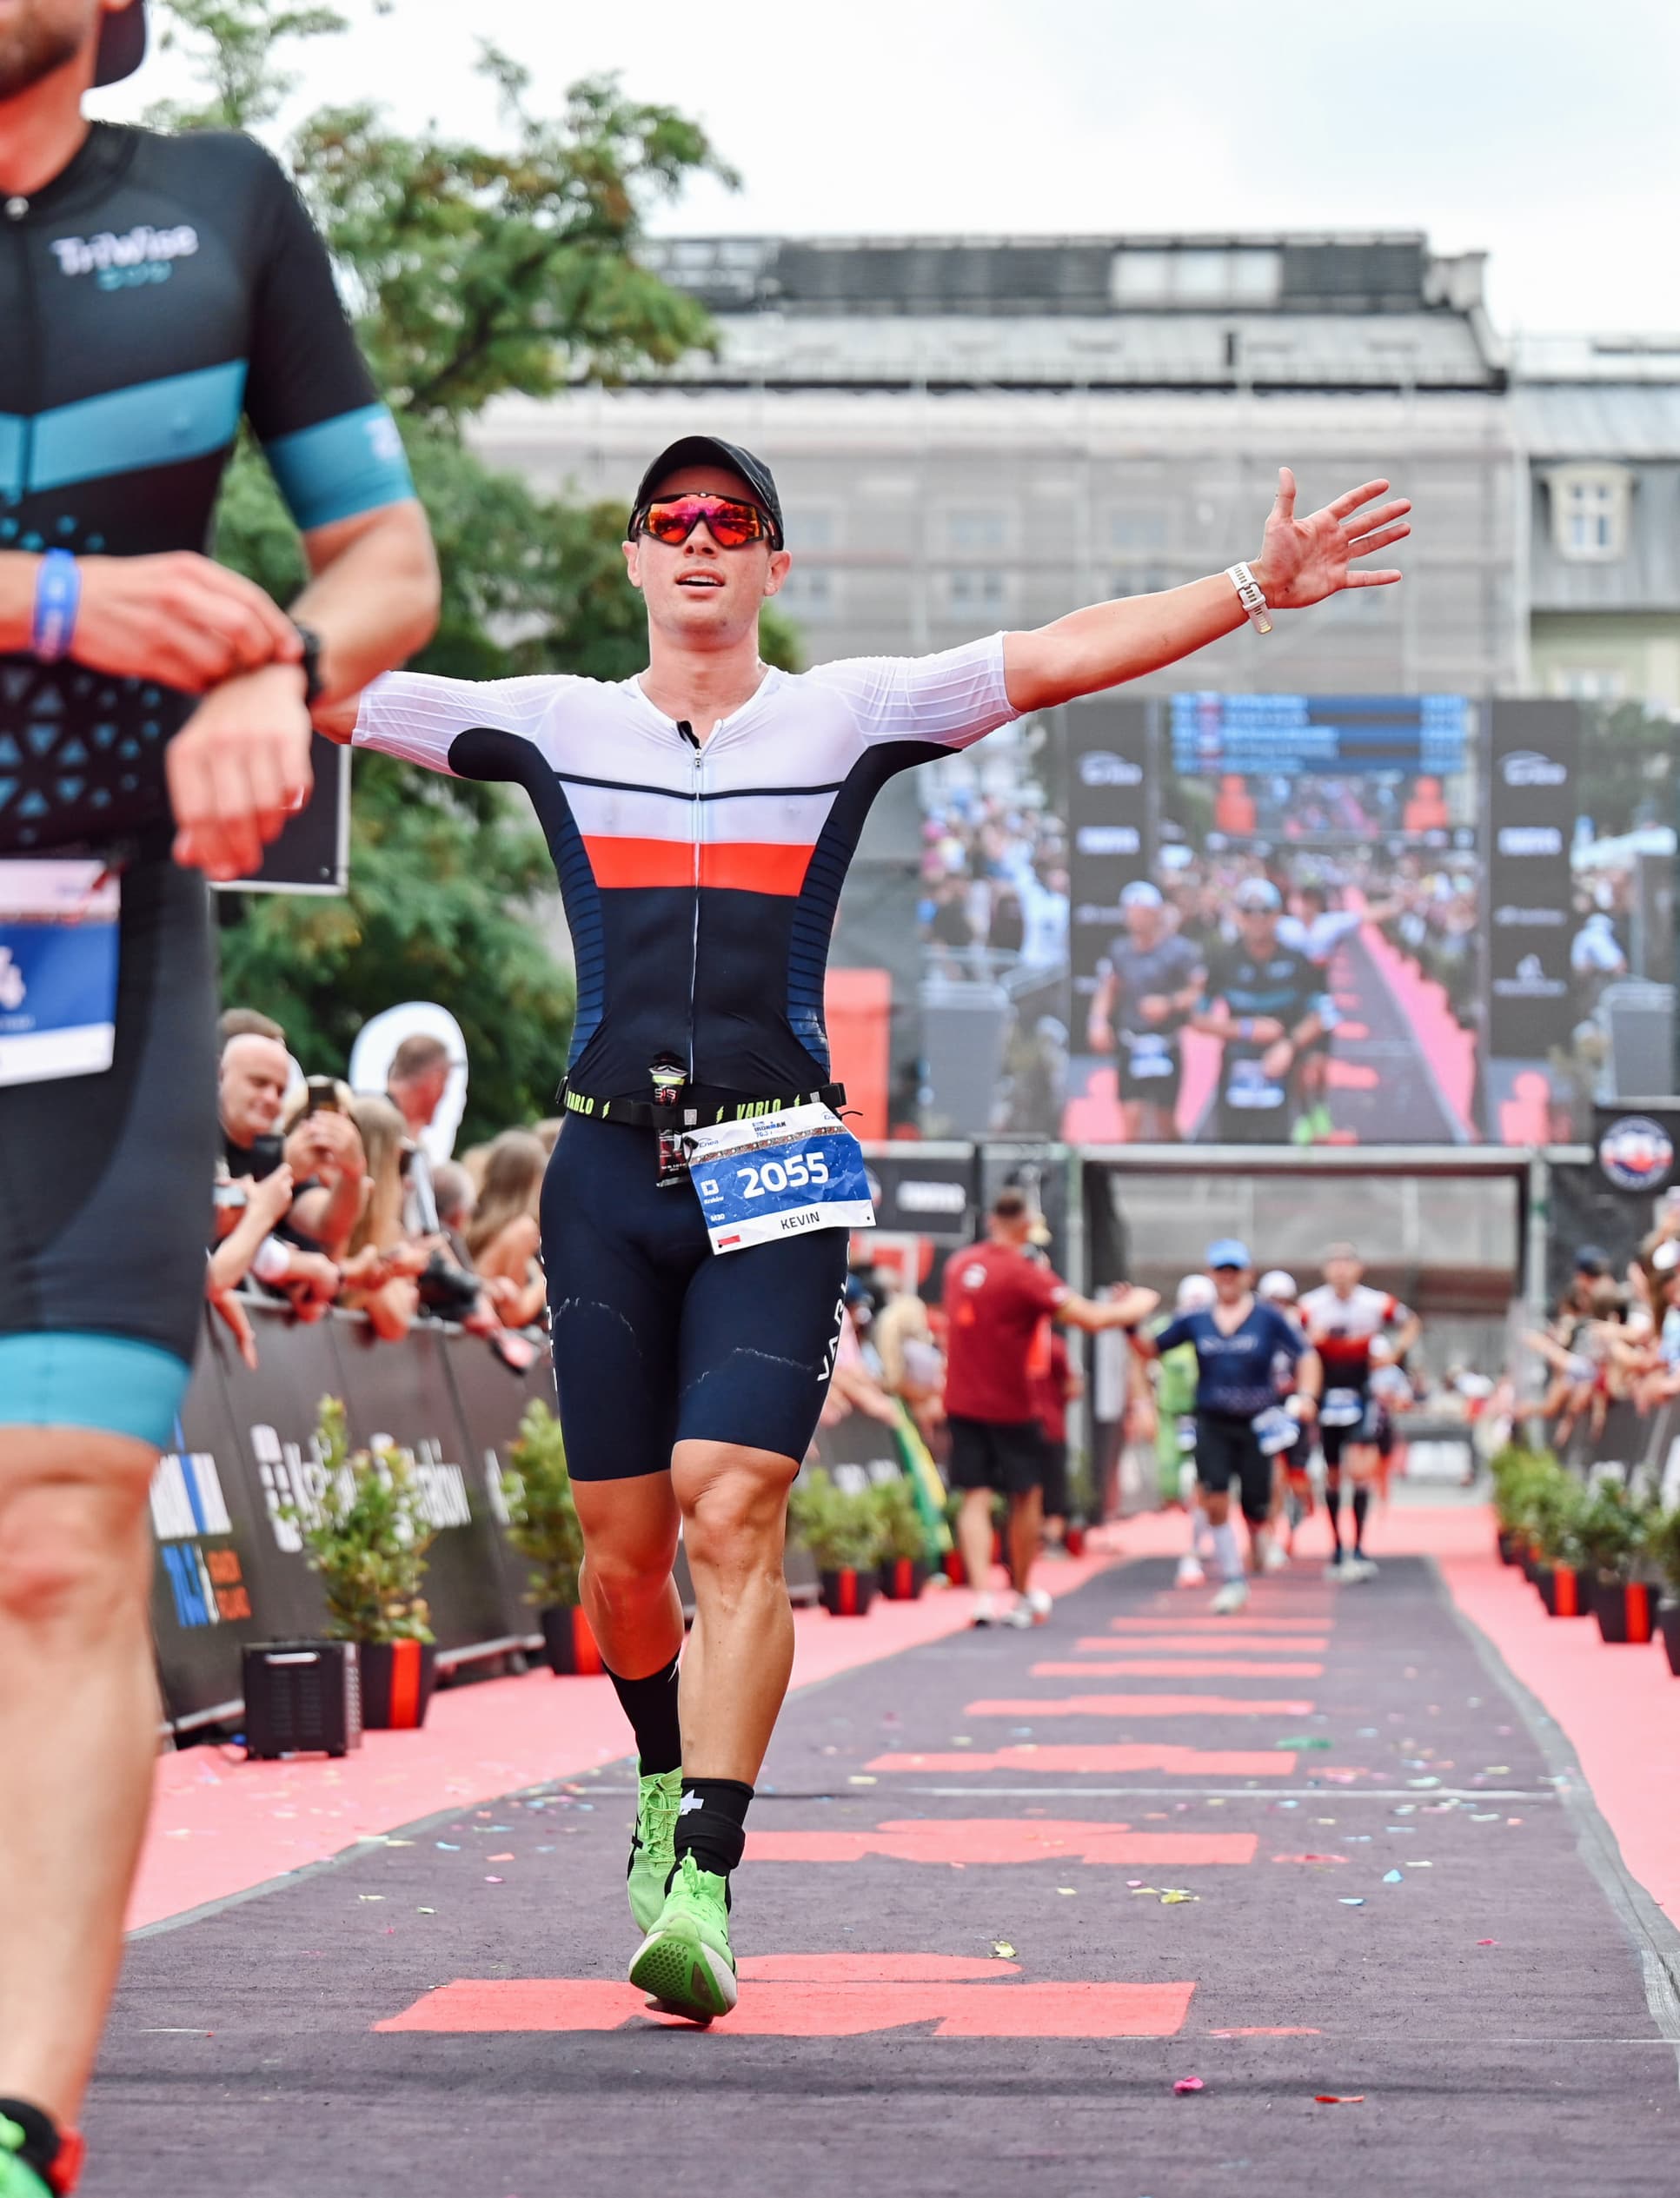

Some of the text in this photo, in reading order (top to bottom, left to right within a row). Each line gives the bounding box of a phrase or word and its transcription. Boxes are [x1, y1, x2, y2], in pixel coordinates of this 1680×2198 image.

[736, 1098, 781, 1120] VARLO
[736, 1152, 829, 1199] 2055
[781, 1212, 820, 1230] KEVIN
